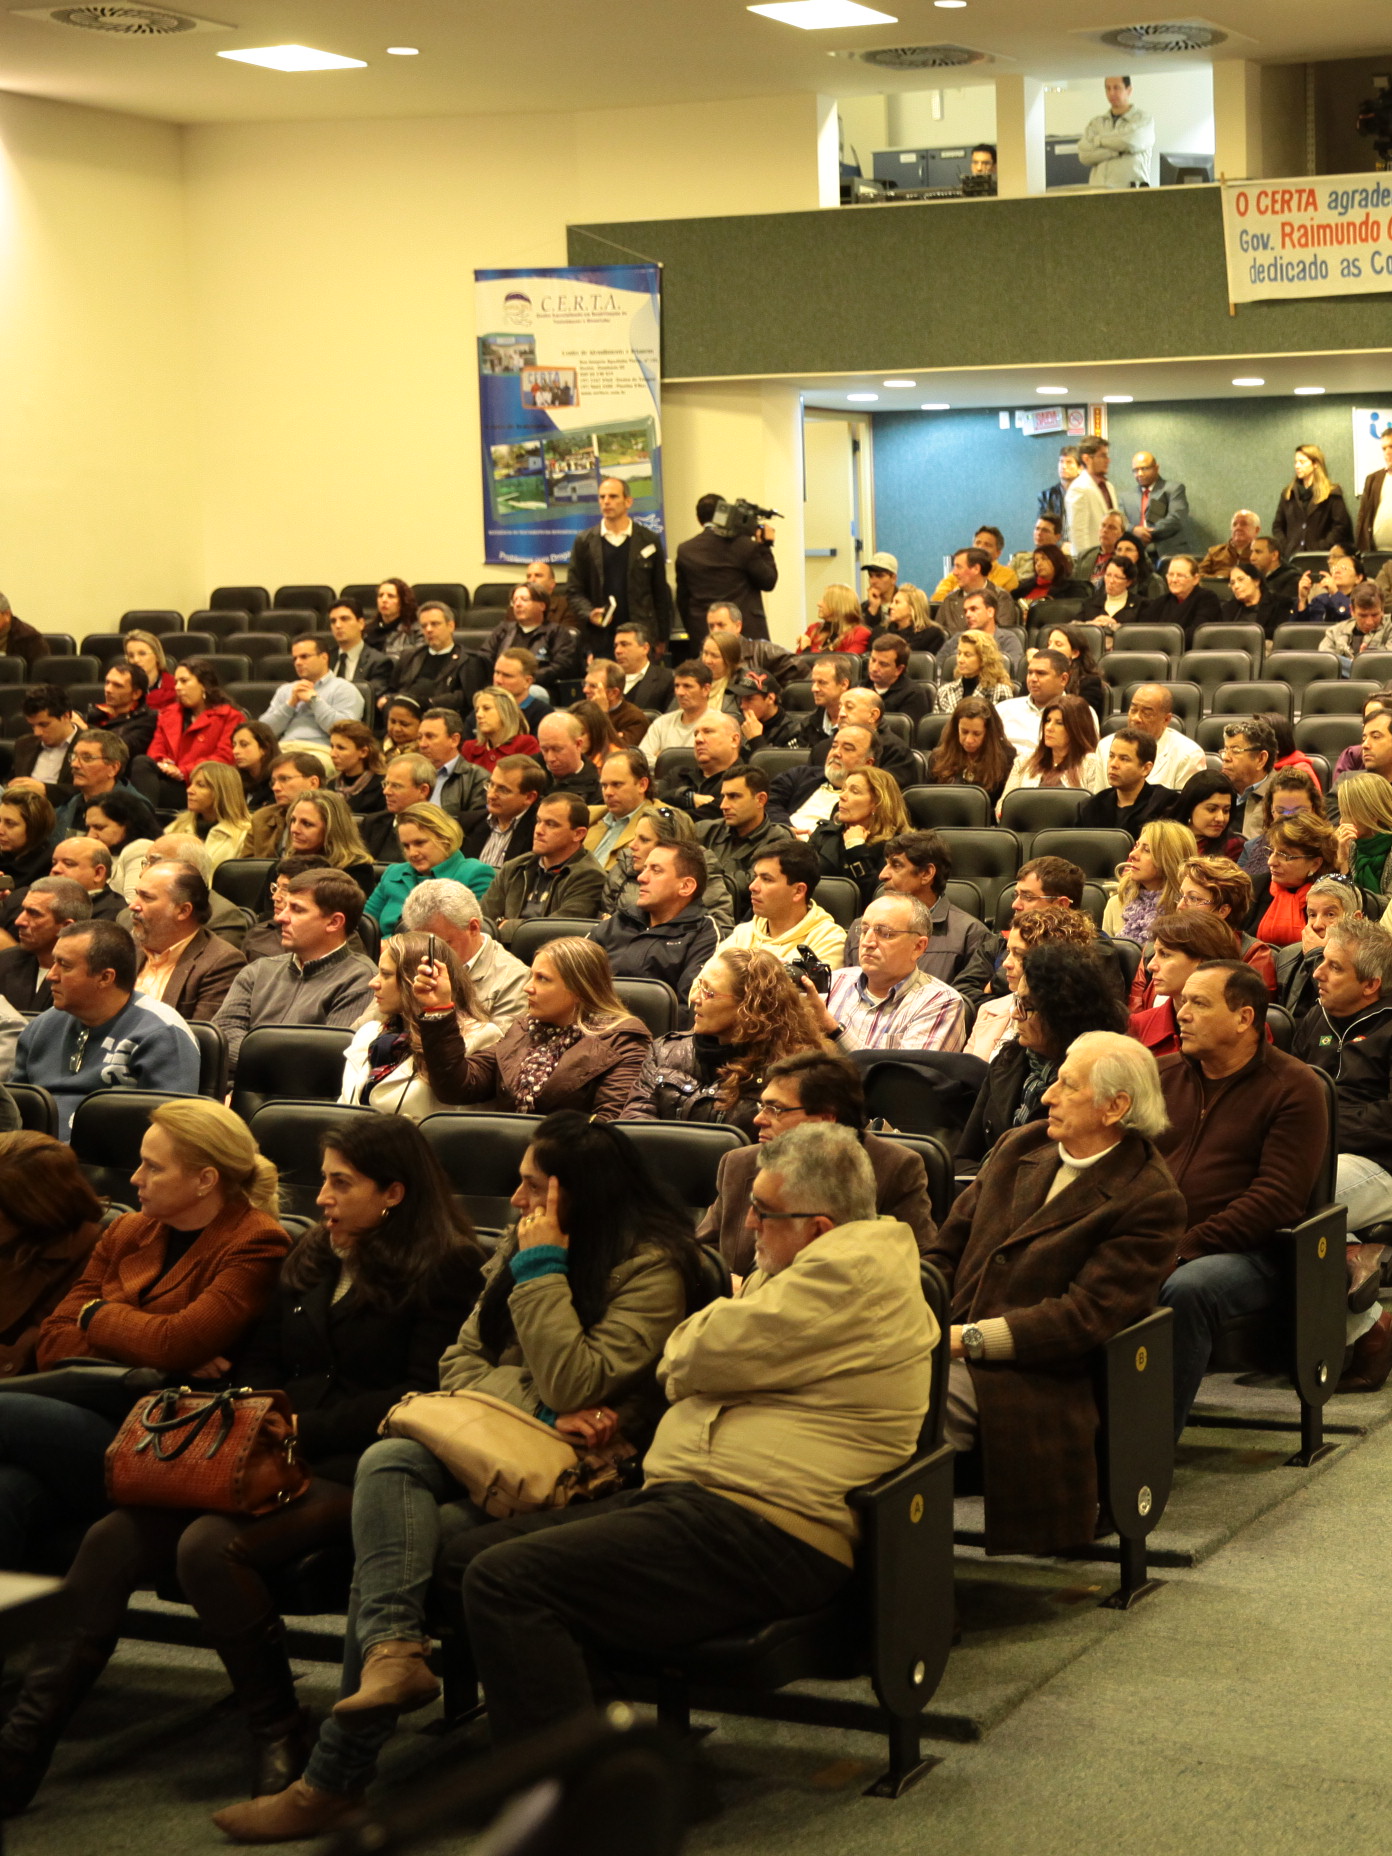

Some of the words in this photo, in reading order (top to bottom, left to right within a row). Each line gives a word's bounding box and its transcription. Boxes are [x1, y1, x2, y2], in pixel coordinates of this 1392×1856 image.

[1236, 191, 1249, 217] O
[1256, 188, 1318, 216] CERTA
[1239, 228, 1275, 253] Gov.
[1281, 212, 1381, 250] Raimundo
[1250, 253, 1329, 284] dedicado
[1340, 257, 1362, 279] as
